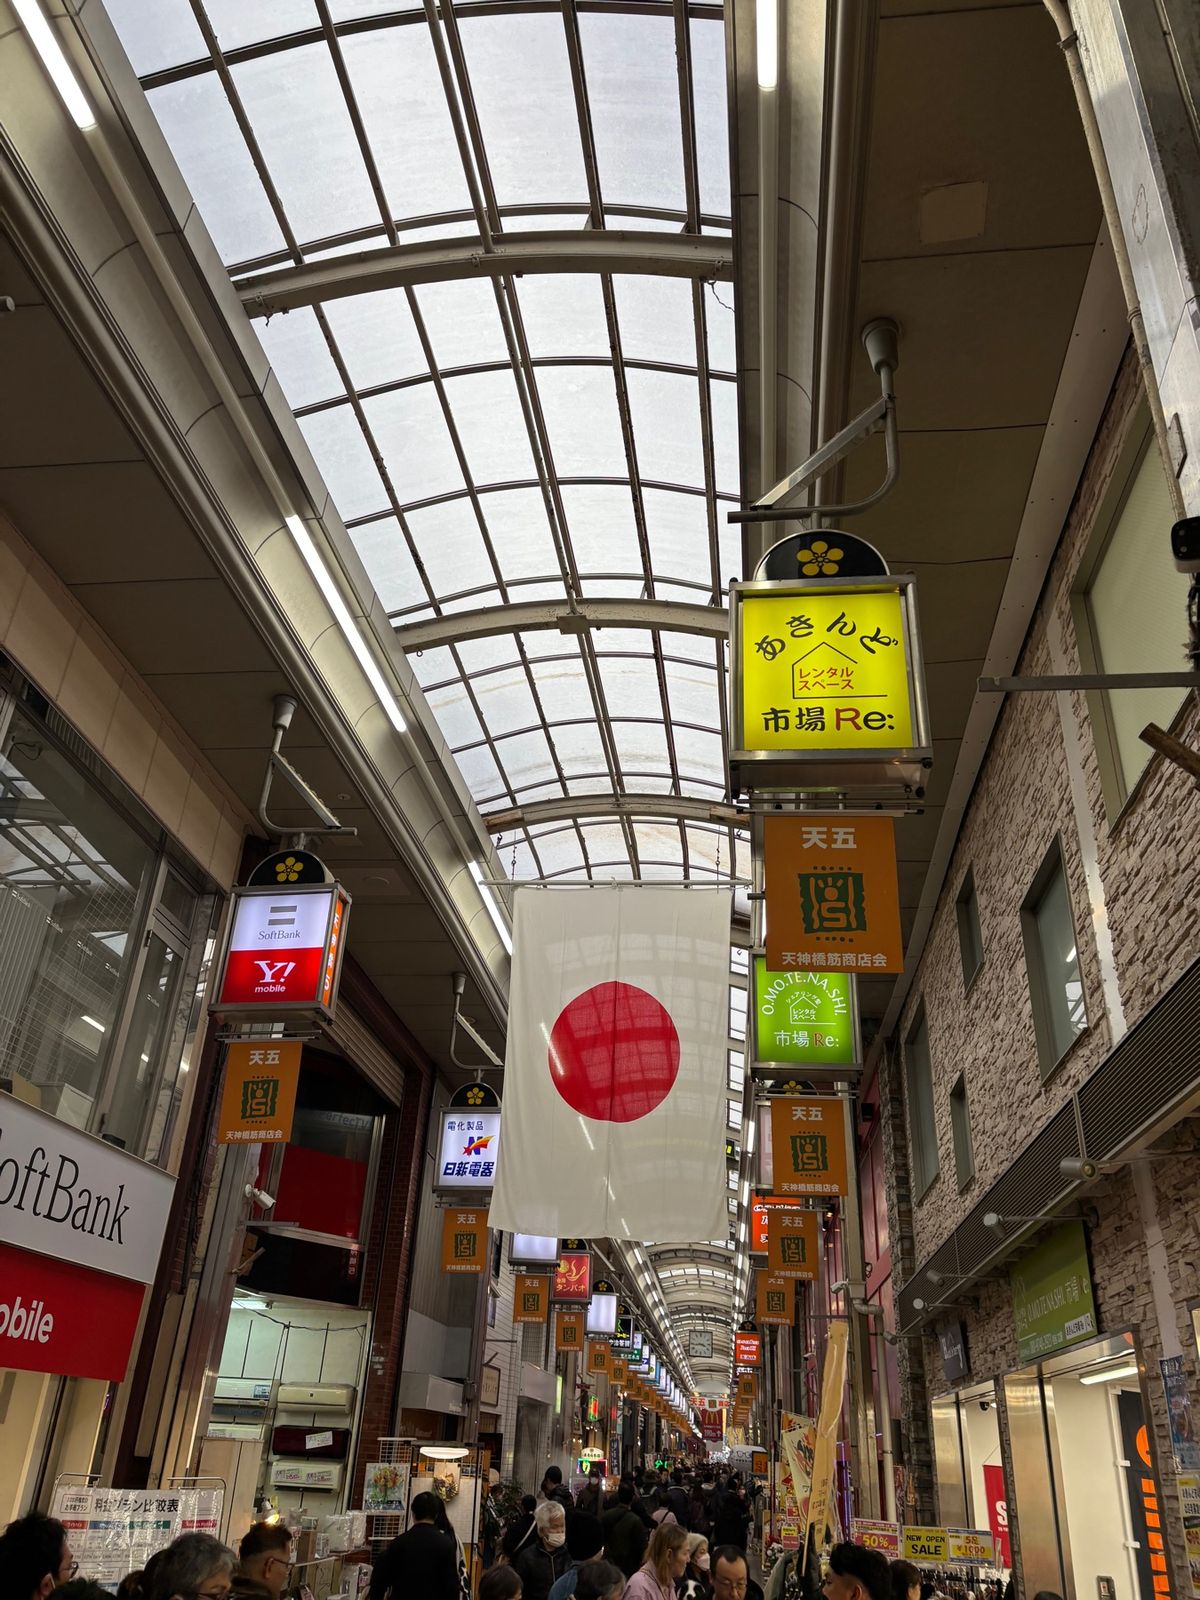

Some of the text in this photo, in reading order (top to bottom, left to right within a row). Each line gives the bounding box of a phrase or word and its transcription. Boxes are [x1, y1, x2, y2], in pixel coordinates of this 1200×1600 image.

[754, 612, 899, 662] あきんど
[798, 666, 854, 679] レンタル
[798, 678, 855, 691] スペース
[761, 707, 895, 732] 市場 Re:
[801, 827, 858, 849] 天五
[258, 930, 301, 940] SoftBank
[781, 951, 888, 968] 天神橋筋商店会
[254, 984, 287, 993] mobile
[774, 1030, 840, 1048] 市場 Re:
[248, 1049, 281, 1066] 天五
[791, 1106, 823, 1121] 天五
[447, 1120, 484, 1131] 電化製品
[443, 1161, 495, 1177] 日新電器
[0, 1127, 130, 1245] oftBank
[457, 1214, 477, 1224] 天五
[781, 1216, 804, 1227] 天五
[0, 1296, 54, 1345] obile
[862, 1534, 889, 1548] 50%
[906, 1534, 946, 1543] NEW OPEN
[911, 1544, 942, 1556] SALE
[957, 1545, 986, 1554] ¥1000
